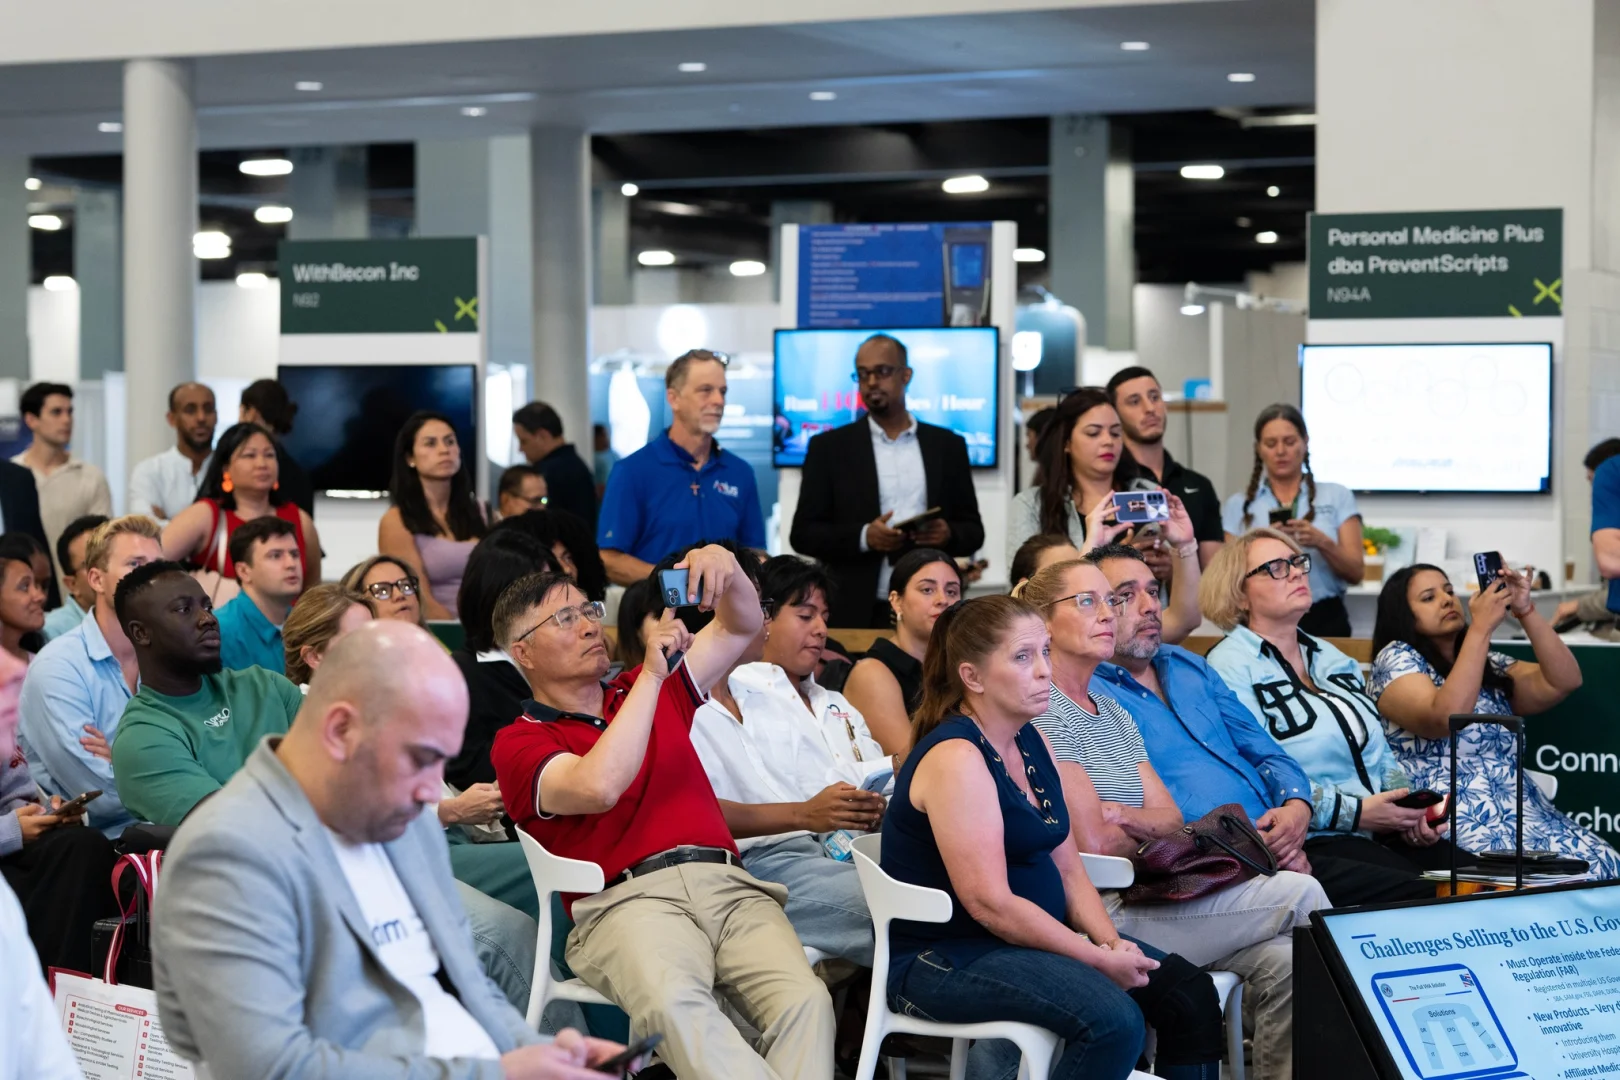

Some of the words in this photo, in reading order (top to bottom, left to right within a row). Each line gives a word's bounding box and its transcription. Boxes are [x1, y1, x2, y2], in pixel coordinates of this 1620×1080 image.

[1328, 227, 1408, 246] Personal
[1412, 225, 1499, 245] Medicine
[1504, 224, 1544, 242] Plus
[292, 262, 386, 283] WithBecon
[389, 261, 420, 281] Inc
[1327, 257, 1364, 275] dba
[1368, 254, 1509, 276] PreventScripts
[1326, 287, 1371, 303] N94A
[1536, 744, 1620, 773] Conn
[1360, 935, 1453, 960] Challenges
[1452, 926, 1513, 949] Selling
[1511, 927, 1530, 942] to
[1529, 922, 1558, 939] the
[1557, 918, 1594, 937] U.S.
[1505, 958, 1529, 969] Must
[1528, 955, 1562, 968] Operate
[1560, 951, 1587, 962] inside
[1586, 948, 1602, 959] the
[1512, 968, 1557, 983] Regulation
[1556, 964, 1580, 978] (FAR)
[1533, 983, 1566, 994] Registered
[1572, 978, 1597, 988] multiple
[1597, 976, 1607, 985] US
[1428, 1008, 1456, 1018] Solutions
[1533, 1012, 1554, 1022] New
[1552, 1006, 1590, 1020] Products
[1594, 1003, 1616, 1014] Very
[1539, 1021, 1584, 1035] innovative
[1561, 1035, 1600, 1047] Introducing
[1598, 1032, 1617, 1042] them
[1568, 1048, 1602, 1061] University
[1564, 1065, 1598, 1079] Affiliated
[1597, 1061, 1620, 1074] Medic
